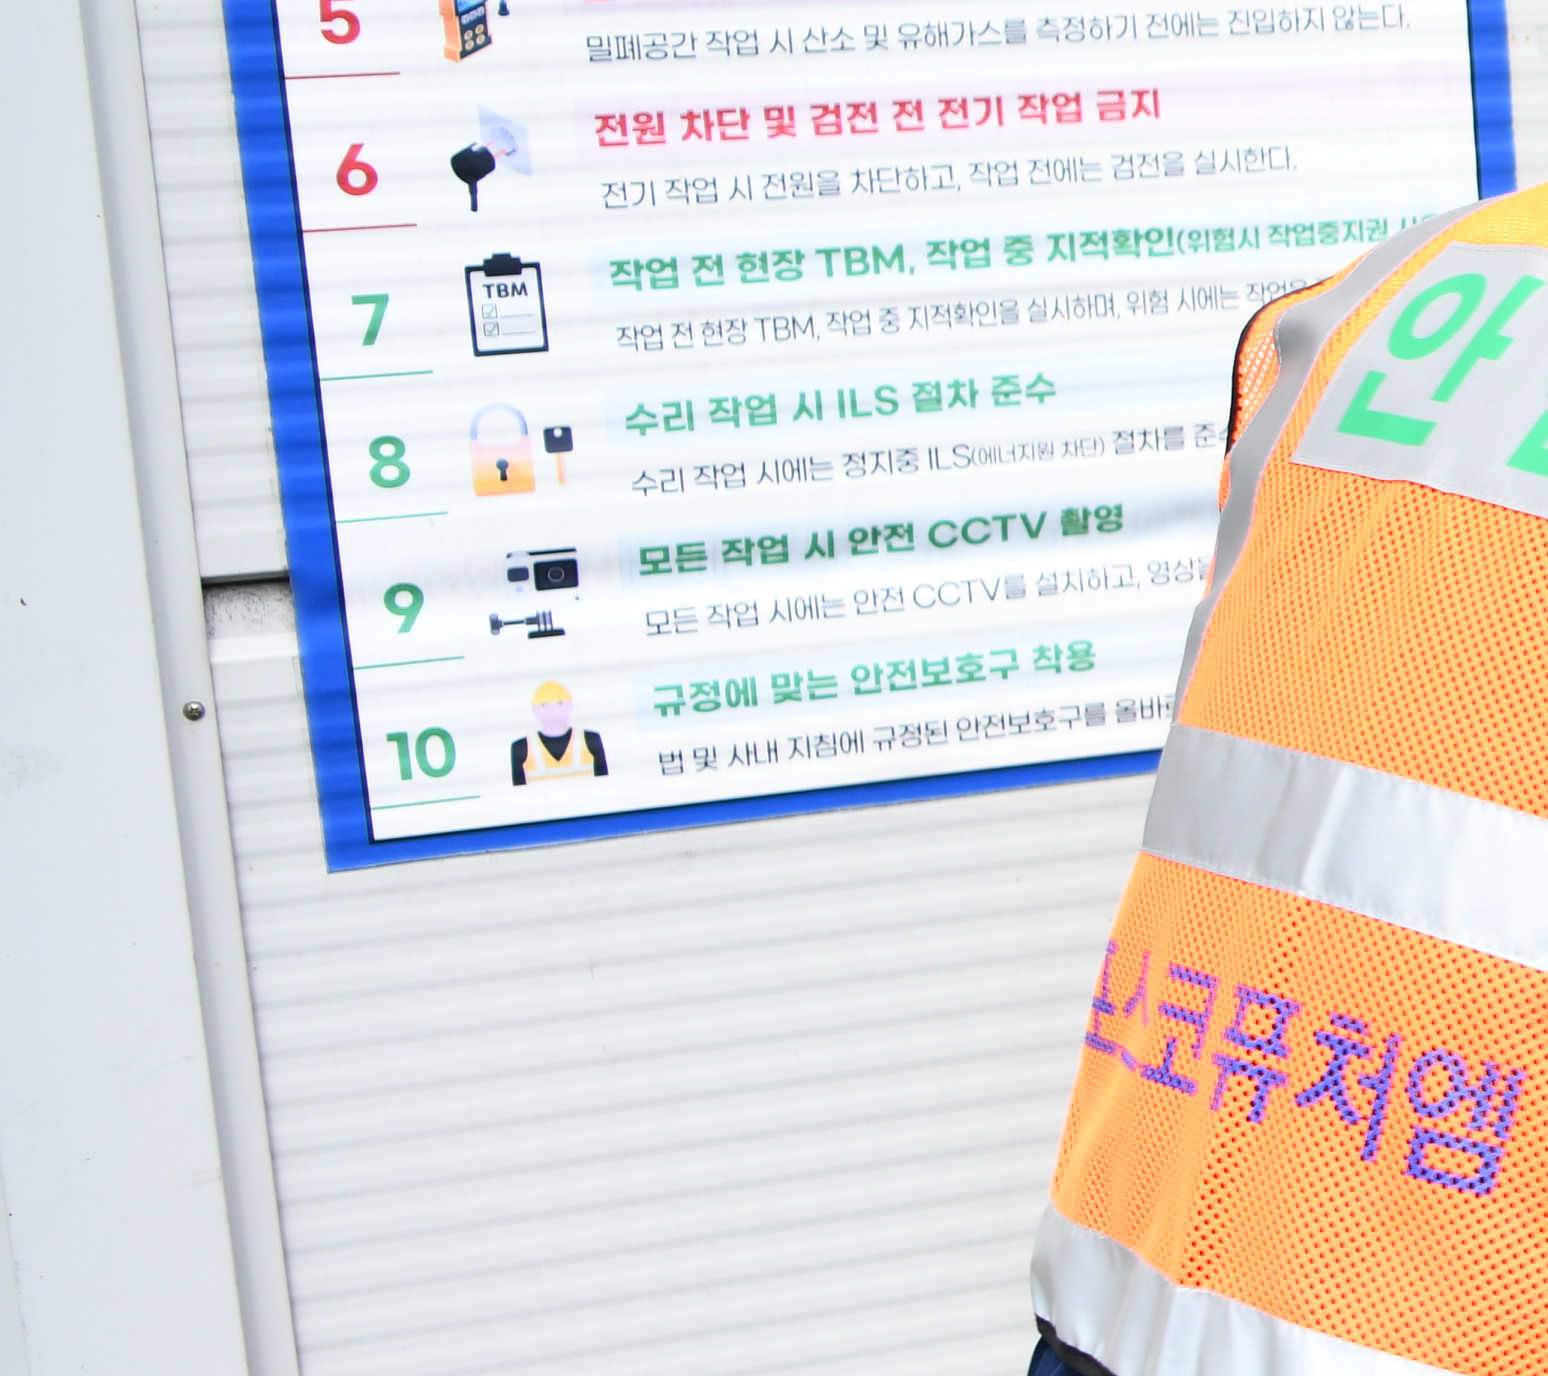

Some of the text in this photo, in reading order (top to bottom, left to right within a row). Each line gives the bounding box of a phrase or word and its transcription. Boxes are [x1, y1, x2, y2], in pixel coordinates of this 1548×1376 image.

[594, 88, 1161, 148] 전원 차단 및 검전 전 전기 작업 금지
[335, 143, 378, 196] 6
[610, 257, 679, 292] 작업
[691, 253, 725, 288] 전
[737, 250, 805, 286] 현장
[816, 245, 916, 279] TBM,
[926, 237, 991, 271] 작업
[1003, 235, 1034, 267] 중
[1268, 219, 1388, 247] 작업중지권
[351, 294, 389, 346] 7
[483, 283, 528, 299] TBM
[625, 372, 1056, 437] 수리 작업 시 ILS 절차 준수
[368, 436, 411, 488] 8
[632, 470, 685, 497] 수리
[693, 463, 746, 489] 작업
[756, 458, 835, 486] 시에는
[842, 447, 919, 478] 정지중
[1060, 436, 1105, 461] 차단)
[1113, 425, 1184, 454] 절차를
[639, 504, 1125, 577] 모든 작업 시 안전 CCTV 촬영
[383, 583, 424, 634] 9
[645, 608, 699, 636] 모든
[707, 602, 760, 629] 작업
[768, 596, 846, 624] 시에는
[853, 587, 905, 615] 안전
[912, 573, 1026, 610] CCTV를
[1035, 563, 1140, 595] 설치하고,
[654, 639, 1097, 718] 규정에 맞는 안전보호구 착용
[386, 727, 456, 781] 10
[659, 701, 1106, 776] 법 및 사내 지침에 규정된 안전보호구를
